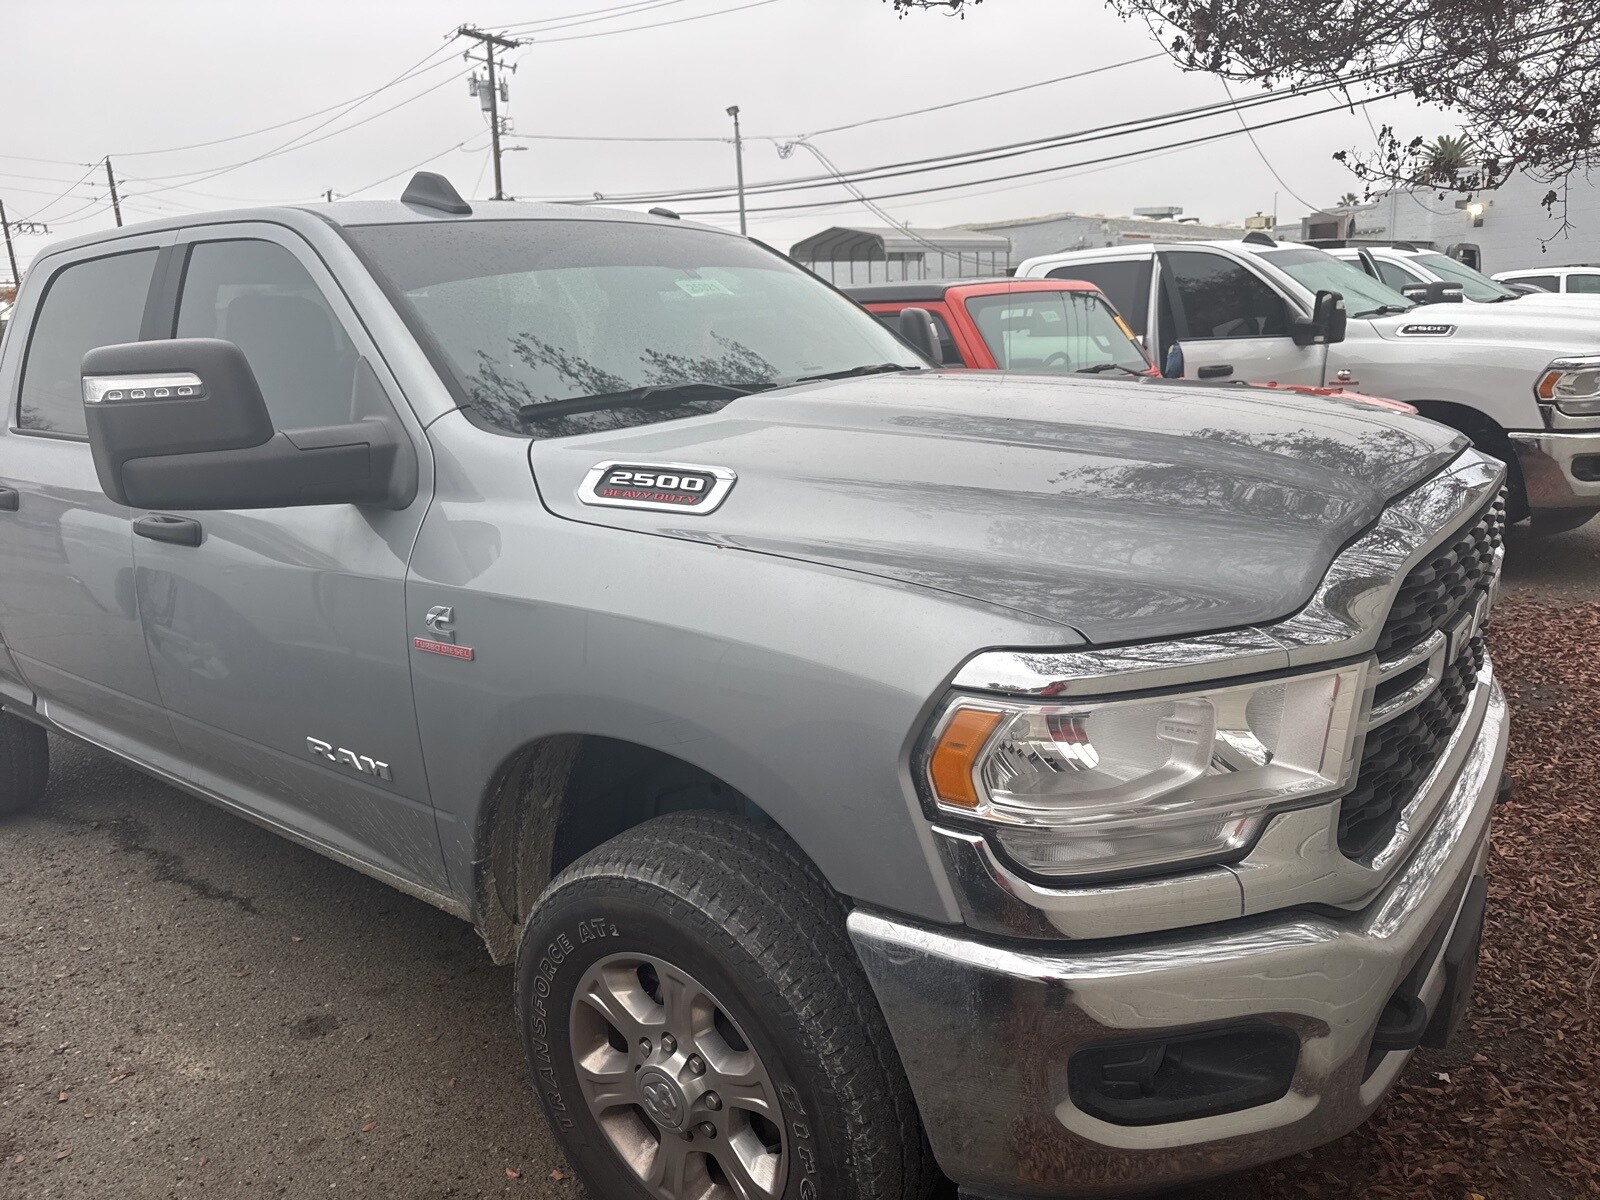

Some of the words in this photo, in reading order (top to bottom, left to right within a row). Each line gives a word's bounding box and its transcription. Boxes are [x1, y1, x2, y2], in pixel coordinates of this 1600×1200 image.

[609, 471, 705, 492] 2500
[603, 488, 652, 499] HEAVY
[653, 493, 700, 503] DUTY
[415, 639, 440, 652] TURBO
[441, 646, 471, 658] DIESEL
[306, 736, 393, 781] RAM
[532, 932, 575, 1134] TRANSFORCE
